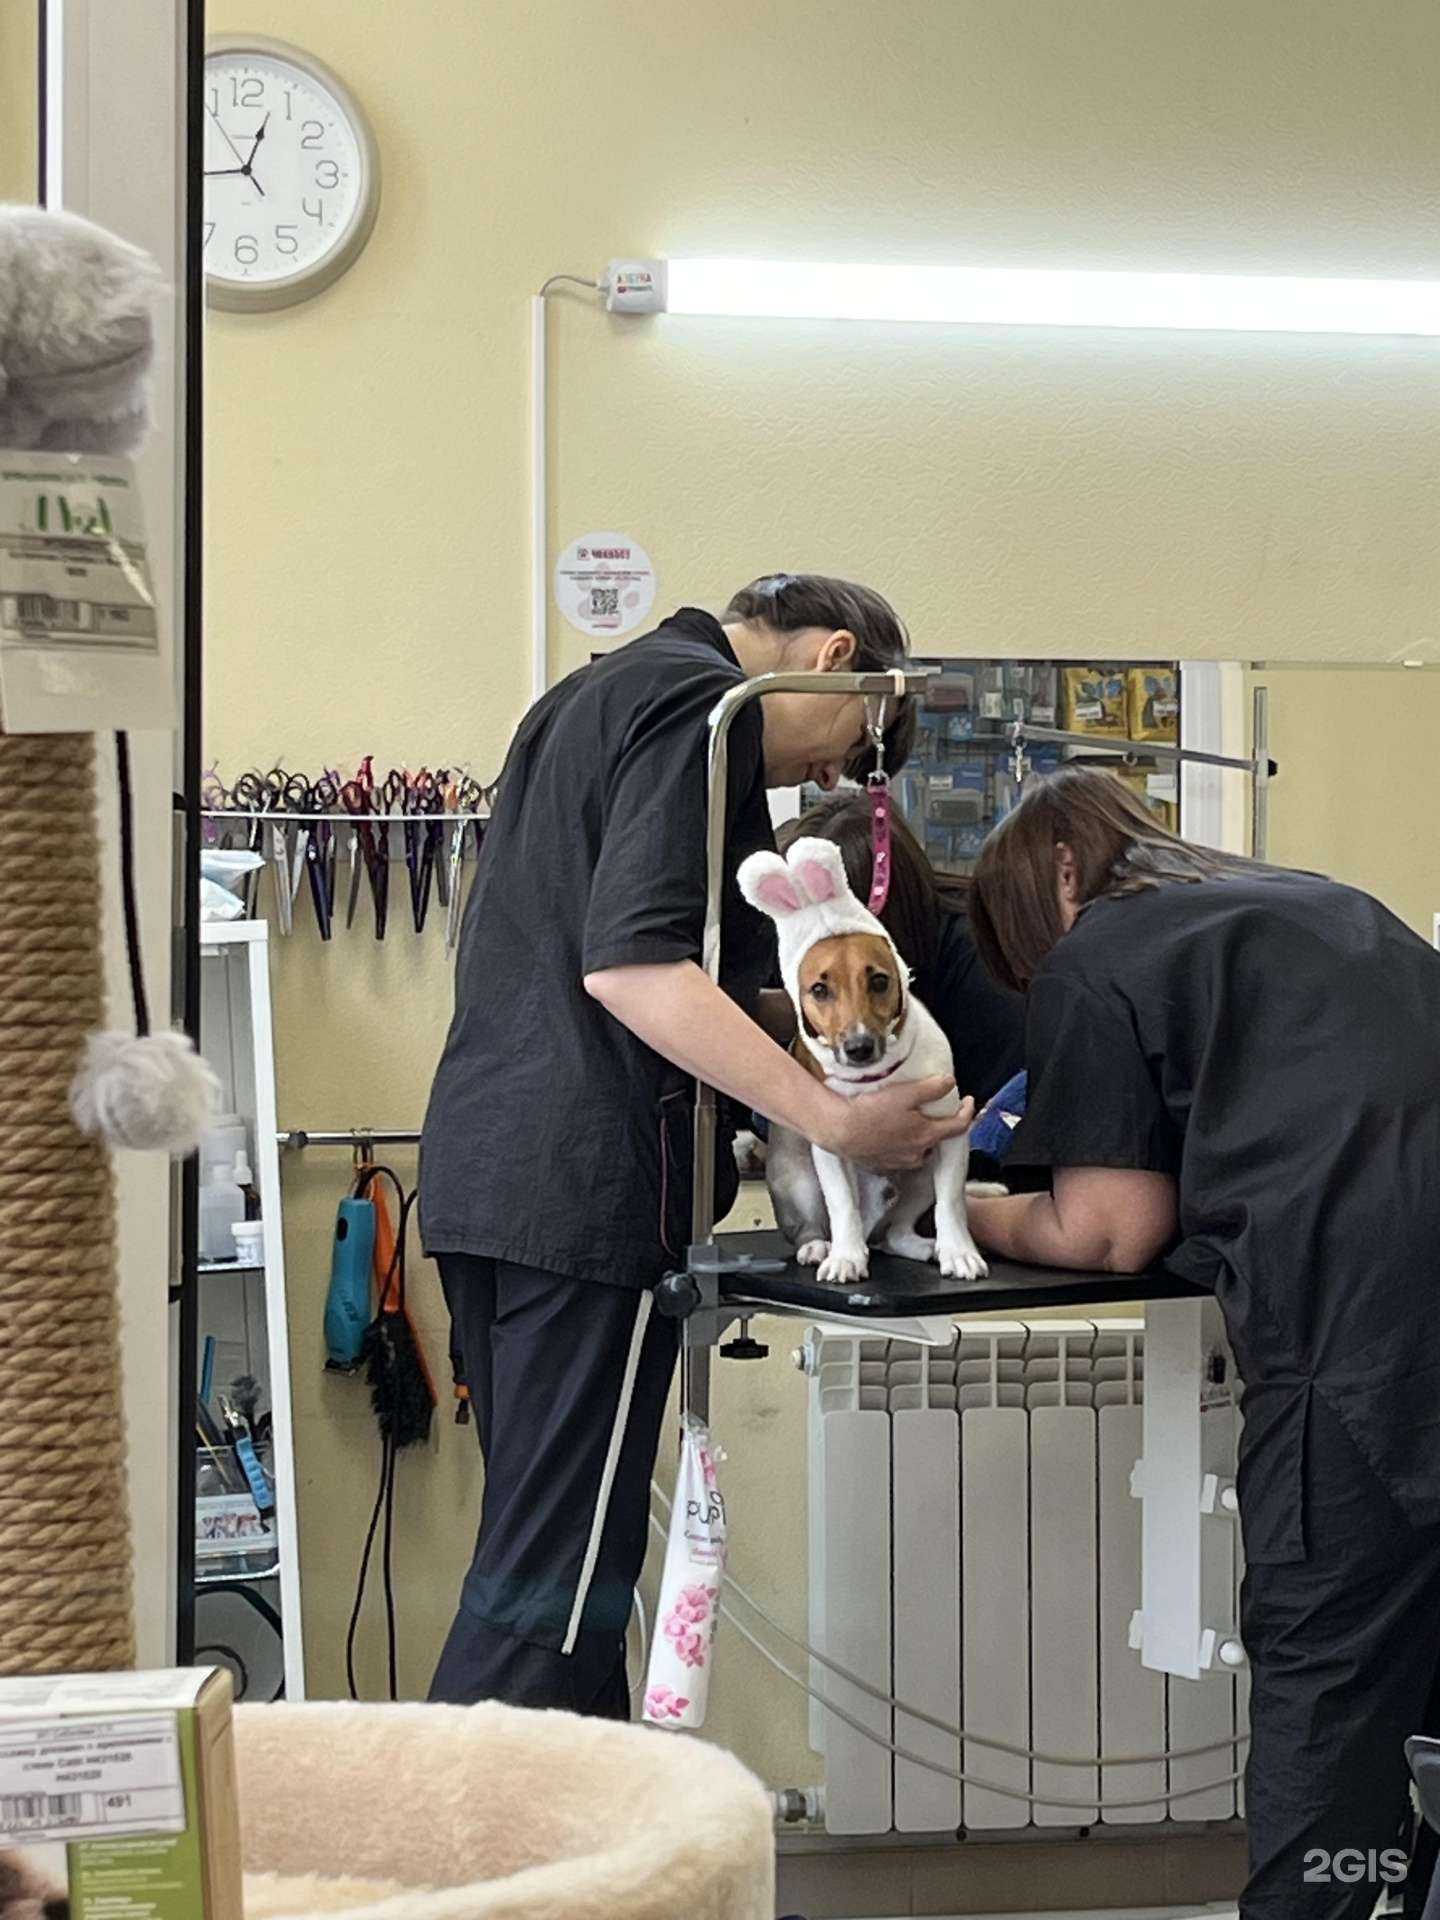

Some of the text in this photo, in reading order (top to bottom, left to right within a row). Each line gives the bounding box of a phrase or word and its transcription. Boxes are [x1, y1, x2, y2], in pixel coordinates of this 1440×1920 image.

[229, 76, 266, 108] 12
[283, 91, 294, 121] 1
[300, 119, 326, 151] 2
[314, 159, 341, 190] 3
[301, 196, 325, 227] 4
[233, 234, 259, 265] 6
[274, 224, 299, 255] 5
